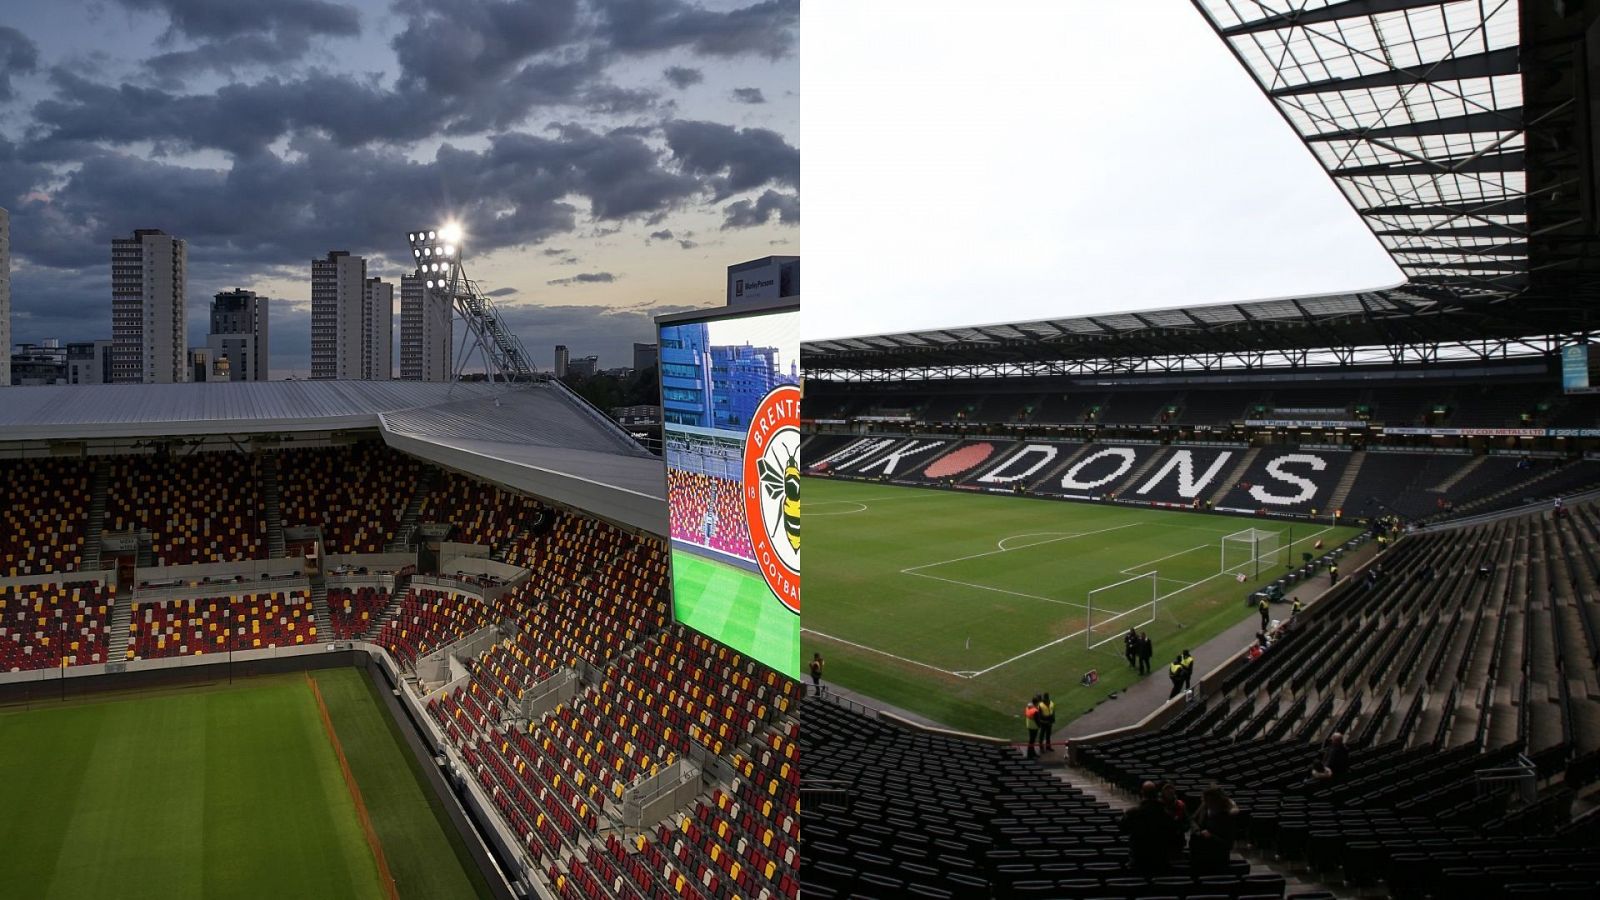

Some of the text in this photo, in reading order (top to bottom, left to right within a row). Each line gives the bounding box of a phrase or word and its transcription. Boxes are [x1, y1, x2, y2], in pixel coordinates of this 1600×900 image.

[1529, 429, 1544, 437] LTD
[1556, 429, 1578, 437] SIGNS
[809, 438, 1327, 505] MK DONS
[748, 486, 755, 499] 18
